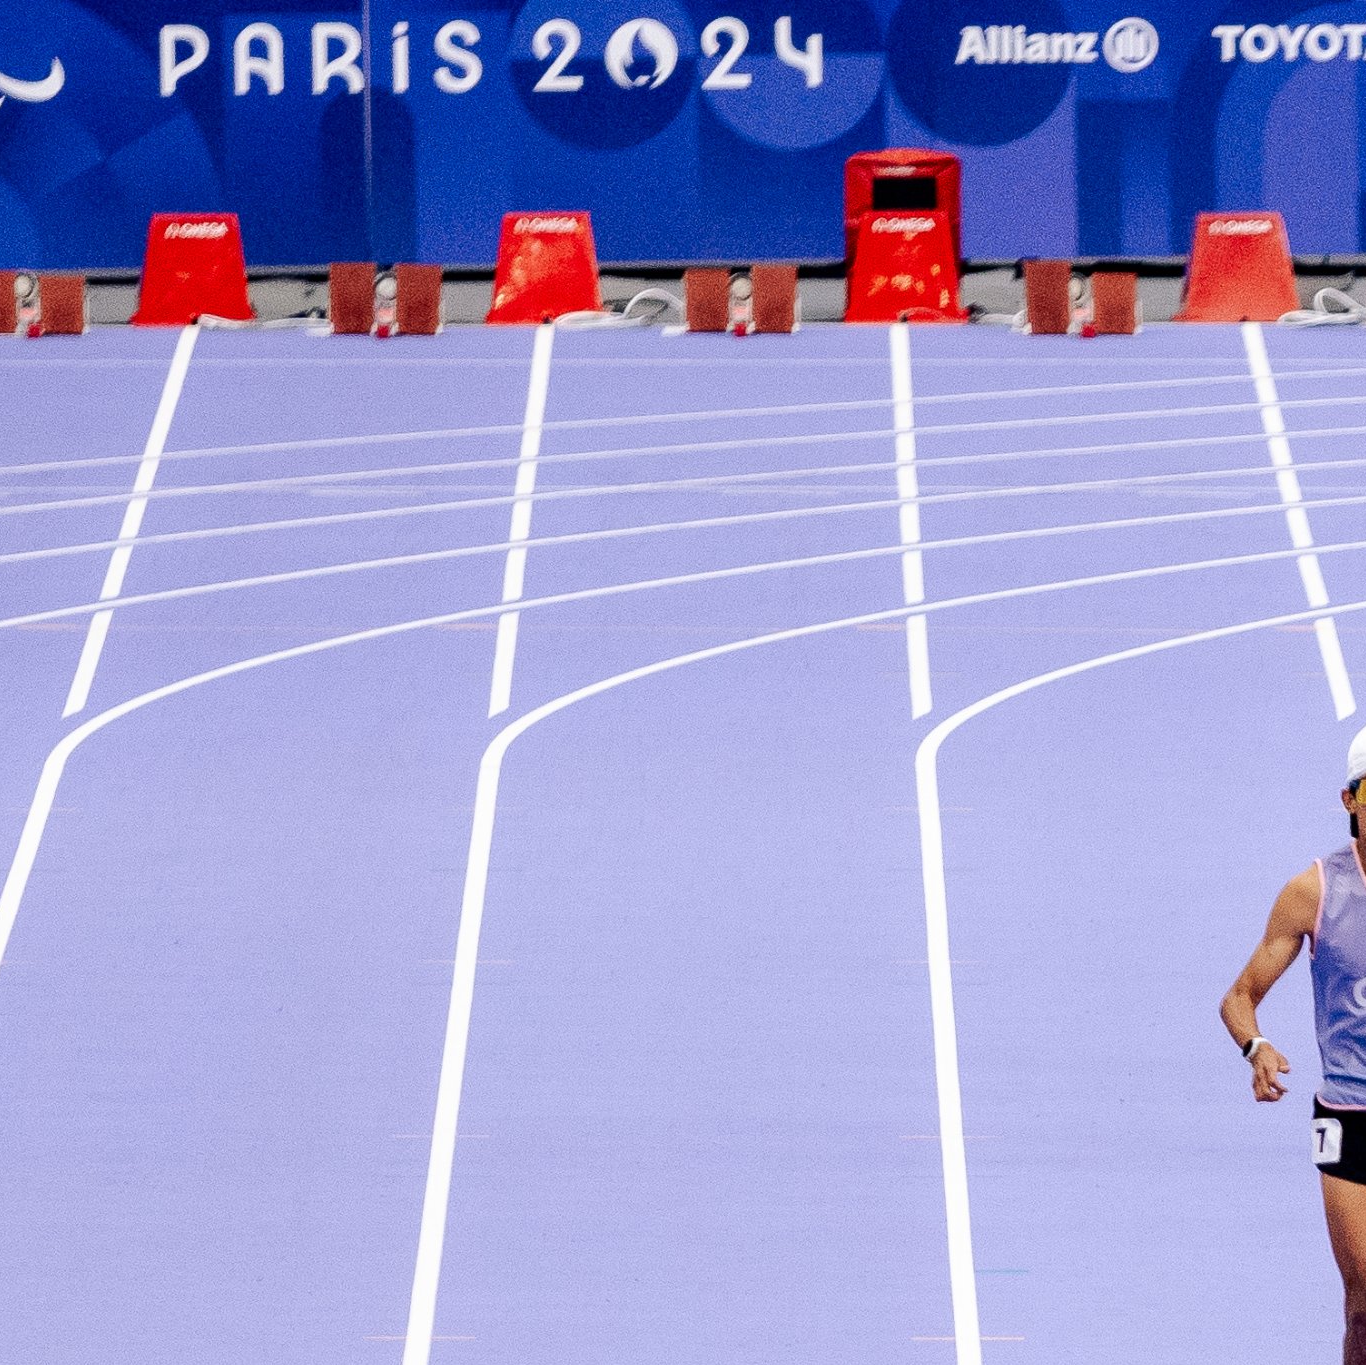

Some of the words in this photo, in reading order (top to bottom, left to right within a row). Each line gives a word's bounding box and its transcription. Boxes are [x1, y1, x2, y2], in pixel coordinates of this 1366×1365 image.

[159, 19, 483, 97] PARIS
[532, 15, 825, 93] 2024
[954, 24, 1099, 65] Allianz
